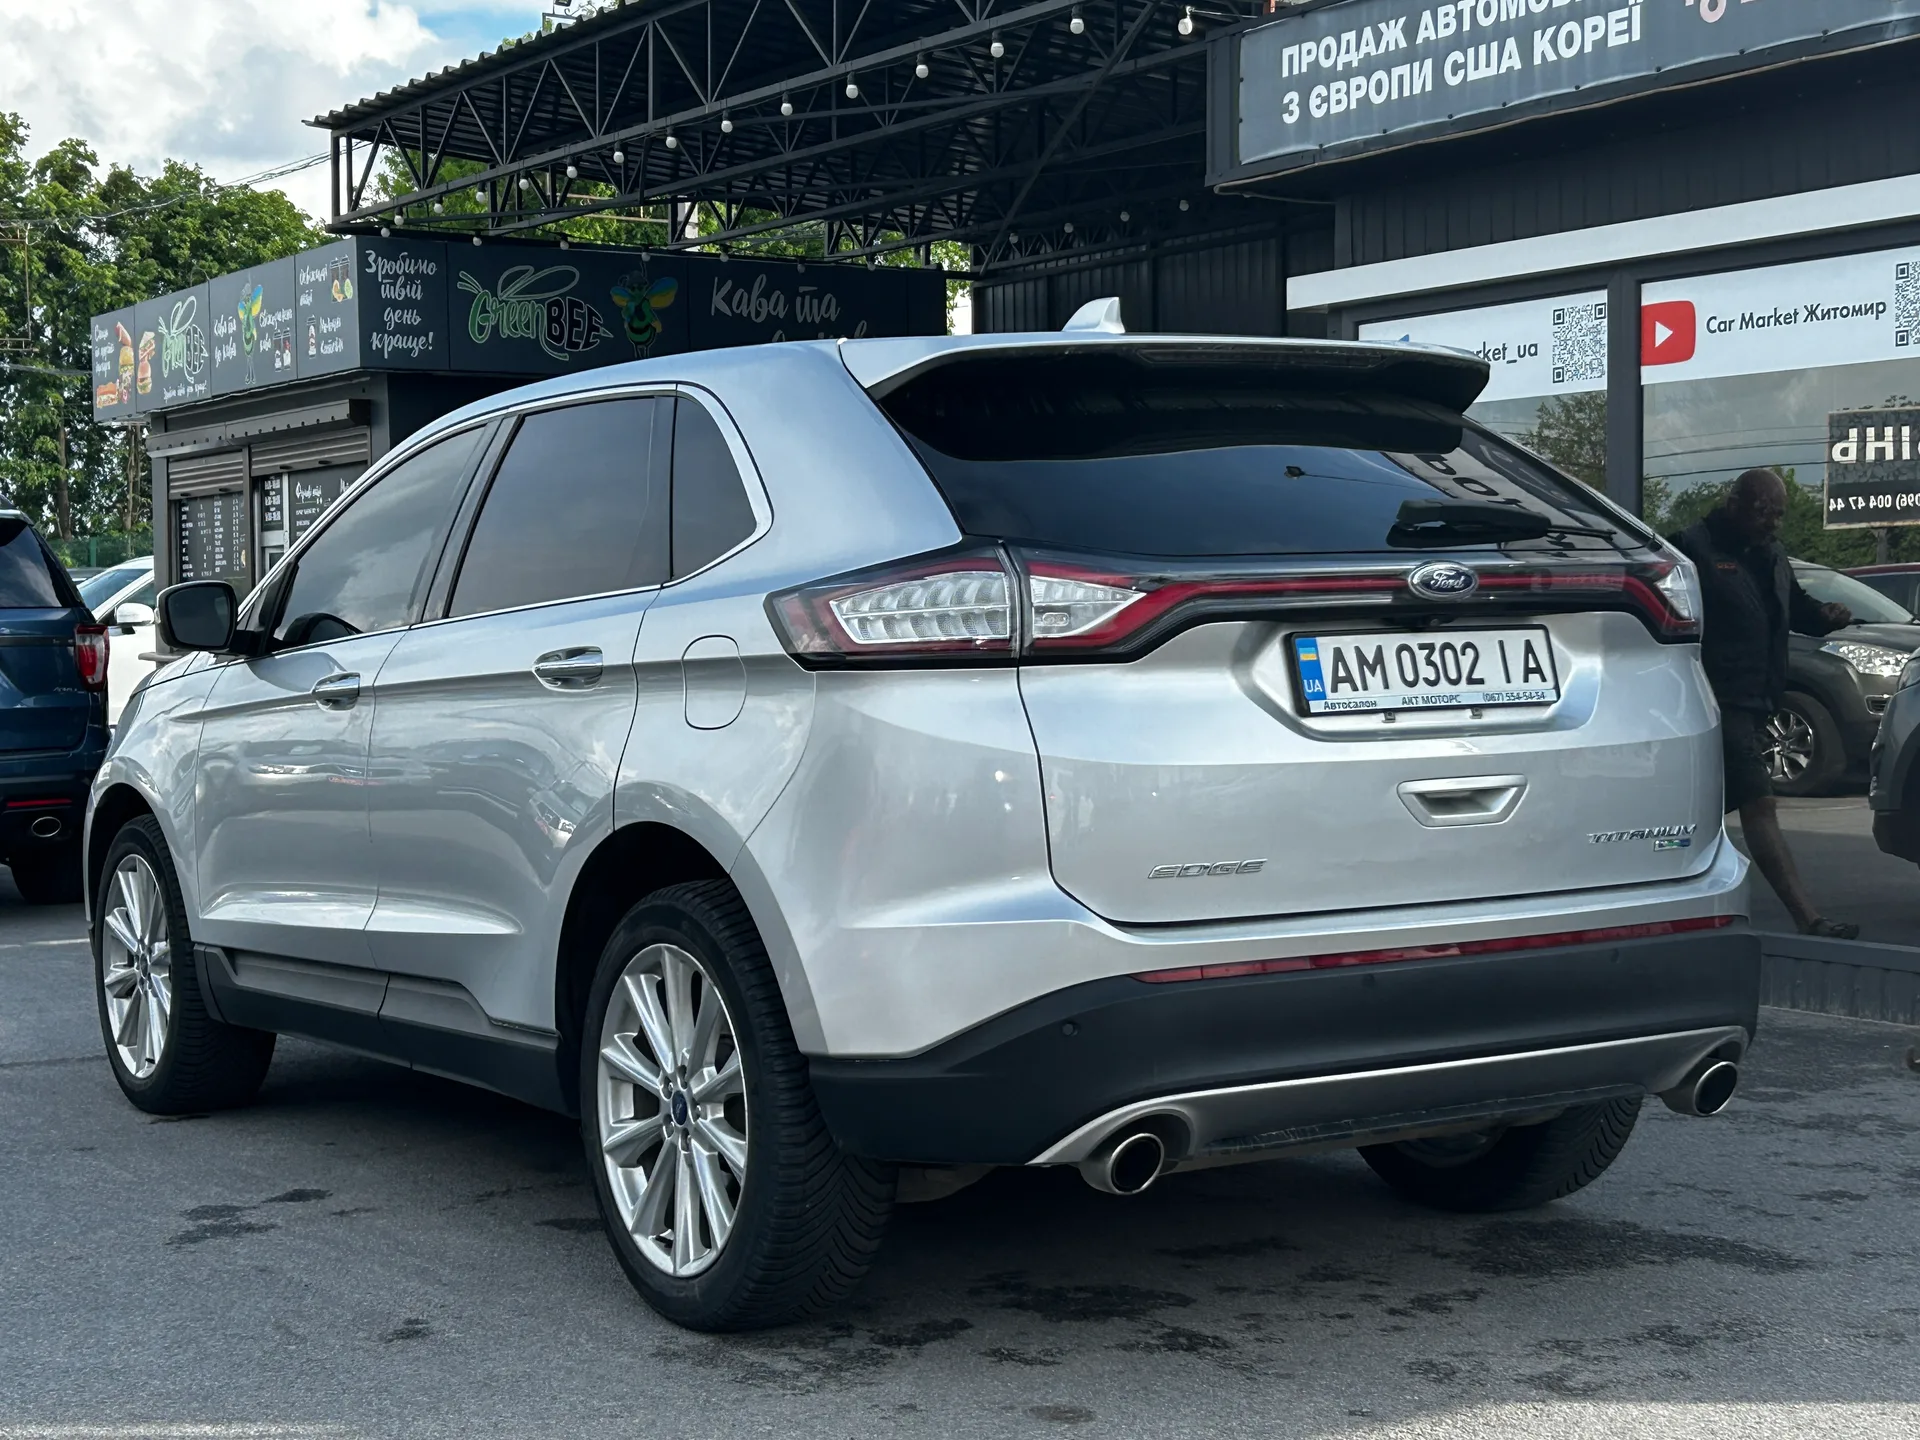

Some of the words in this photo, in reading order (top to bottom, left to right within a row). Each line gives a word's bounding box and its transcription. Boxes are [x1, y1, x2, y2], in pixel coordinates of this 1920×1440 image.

[1282, 16, 1407, 78] ПРОДАЖ
[1416, 0, 1583, 45] АВТОМ
[1282, 91, 1300, 124] З
[1309, 57, 1433, 118] ЄВРОПИ
[1443, 36, 1522, 86] США
[1533, 0, 1643, 65] КОРЕЇ
[365, 250, 437, 283] Зробимо
[711, 273, 789, 323] Кава
[796, 286, 841, 324] та
[384, 307, 422, 331] день
[1706, 315, 1736, 334] Car
[1739, 306, 1800, 331] Market
[1803, 300, 1887, 323] Житомир
[371, 331, 434, 359] краще!
[1430, 570, 1465, 589] Ford
[1331, 644, 1390, 693] AM
[1395, 641, 1485, 689] 0302
[1303, 679, 1323, 693] UA
[1323, 699, 1377, 711] Автосалон
[1421, 694, 1461, 705] МОТОРС
[1587, 823, 1697, 844] TITANIUM
[1148, 858, 1268, 879] EDGE
